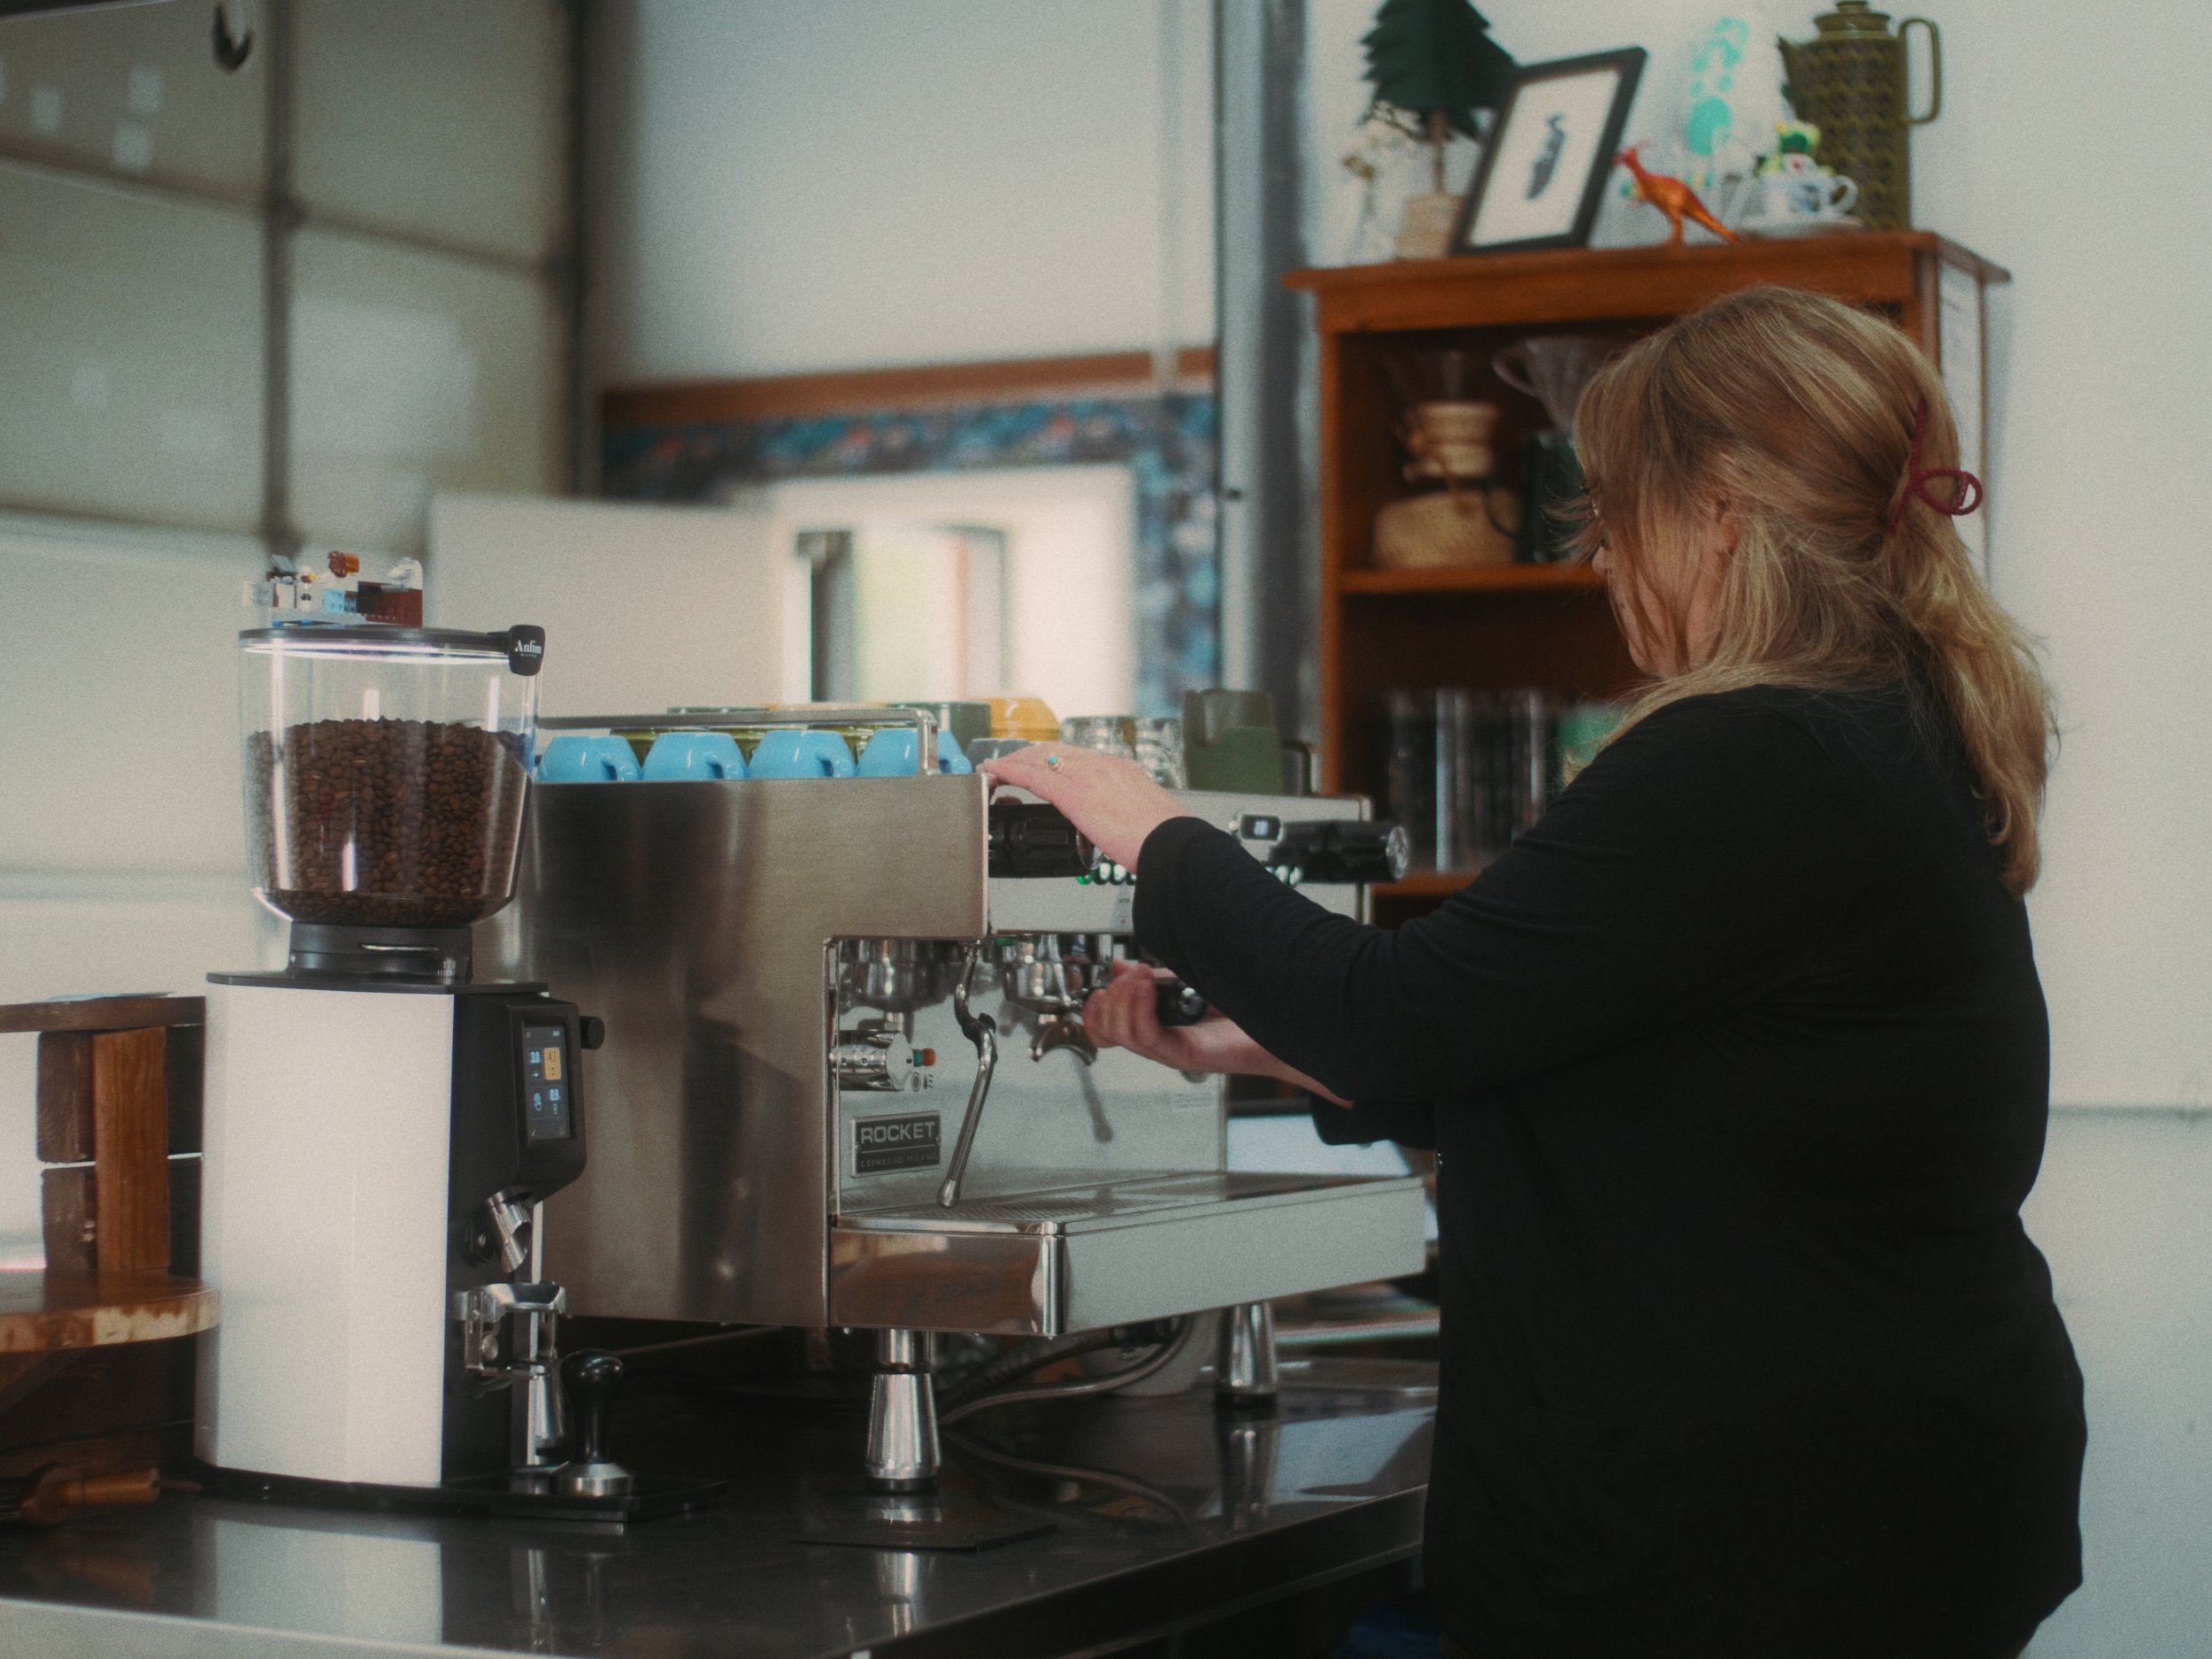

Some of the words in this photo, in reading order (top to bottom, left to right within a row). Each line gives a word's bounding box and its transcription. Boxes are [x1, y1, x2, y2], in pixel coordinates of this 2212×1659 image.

[514, 639, 542, 655] Anfim
[860, 1121, 935, 1144] ROCKET
[860, 1156, 904, 1168] ESPRESSO
[906, 1152, 937, 1163] MILANO
